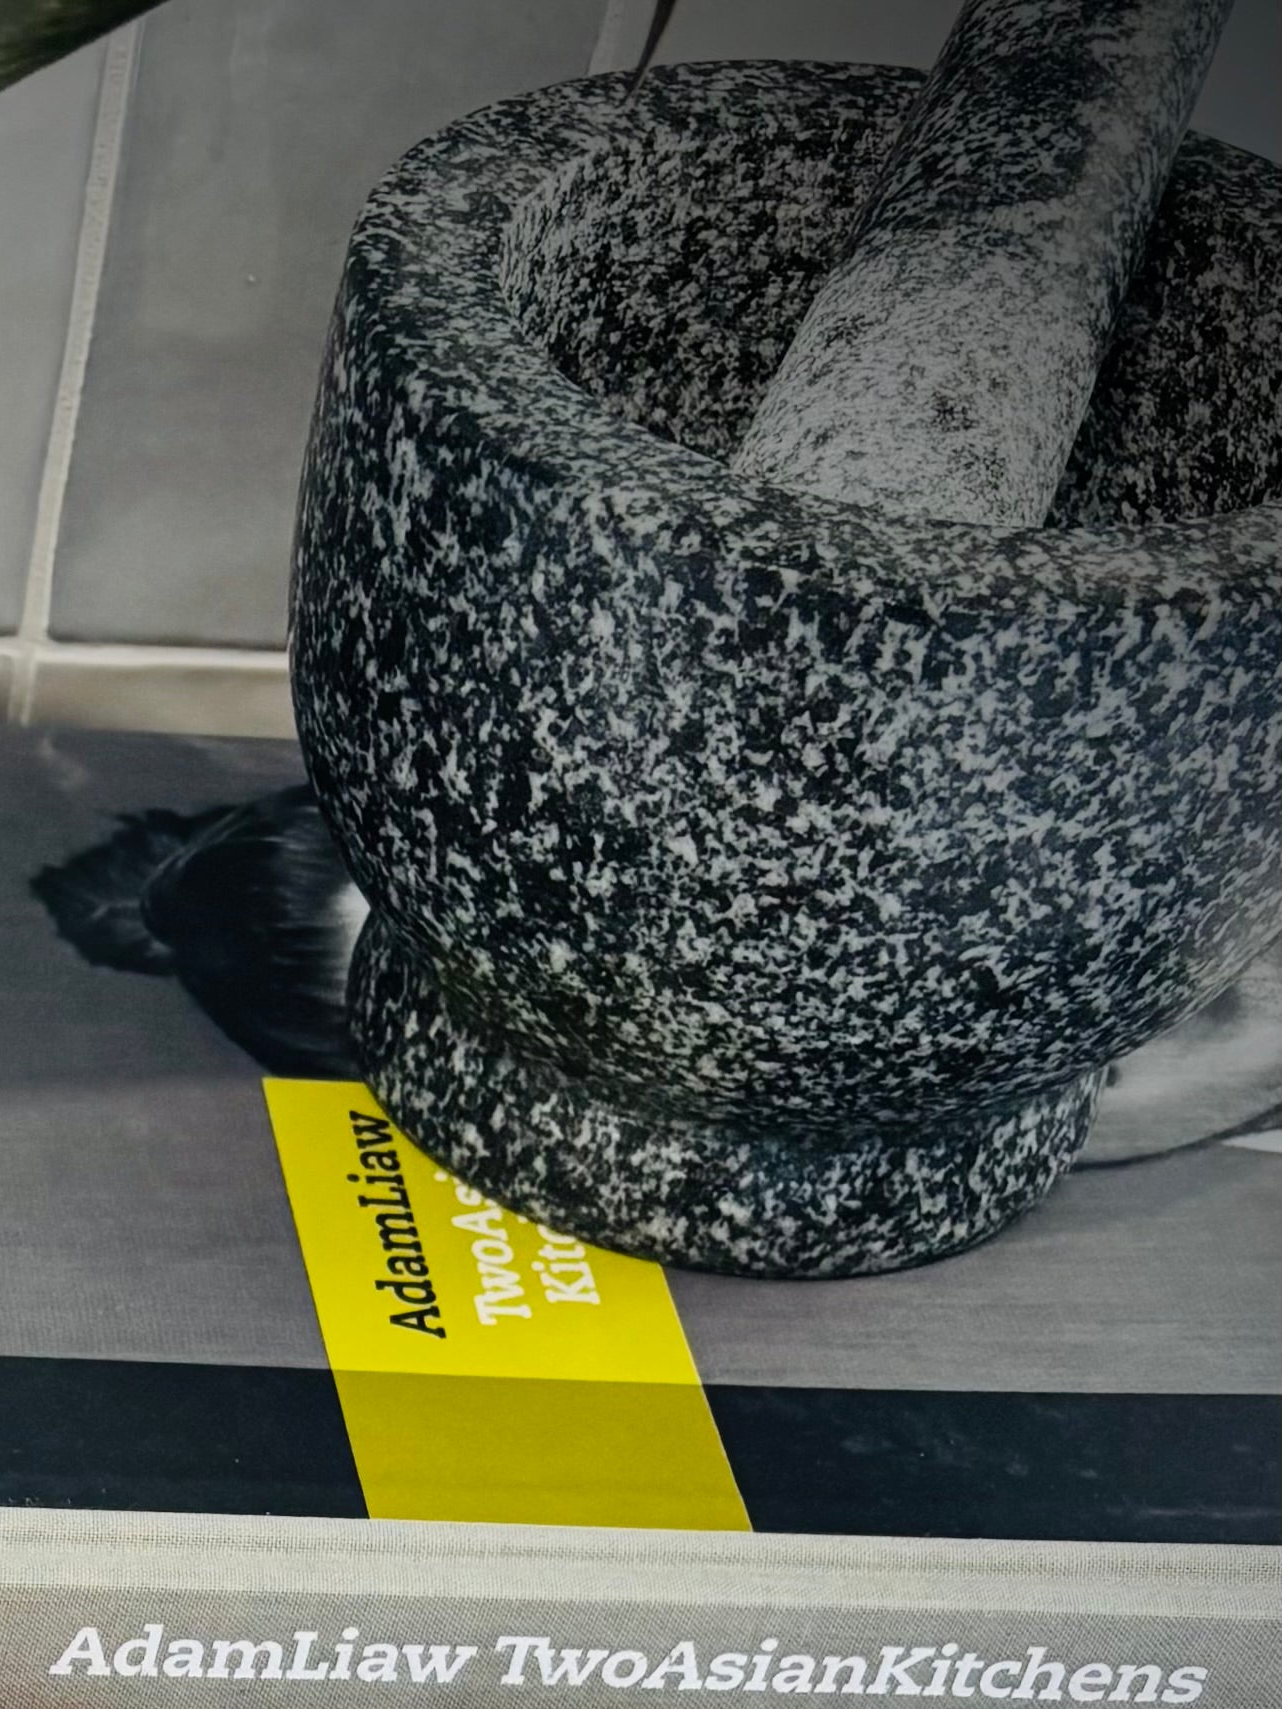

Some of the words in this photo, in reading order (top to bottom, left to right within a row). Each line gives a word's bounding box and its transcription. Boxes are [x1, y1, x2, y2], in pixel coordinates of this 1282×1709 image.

[347, 1110, 447, 1339] AdamLiaw
[432, 1169, 532, 1326] TwoAs
[48, 1623, 478, 1686] AdamLiaw
[489, 1634, 1210, 1704] TwoAsianKitchens
